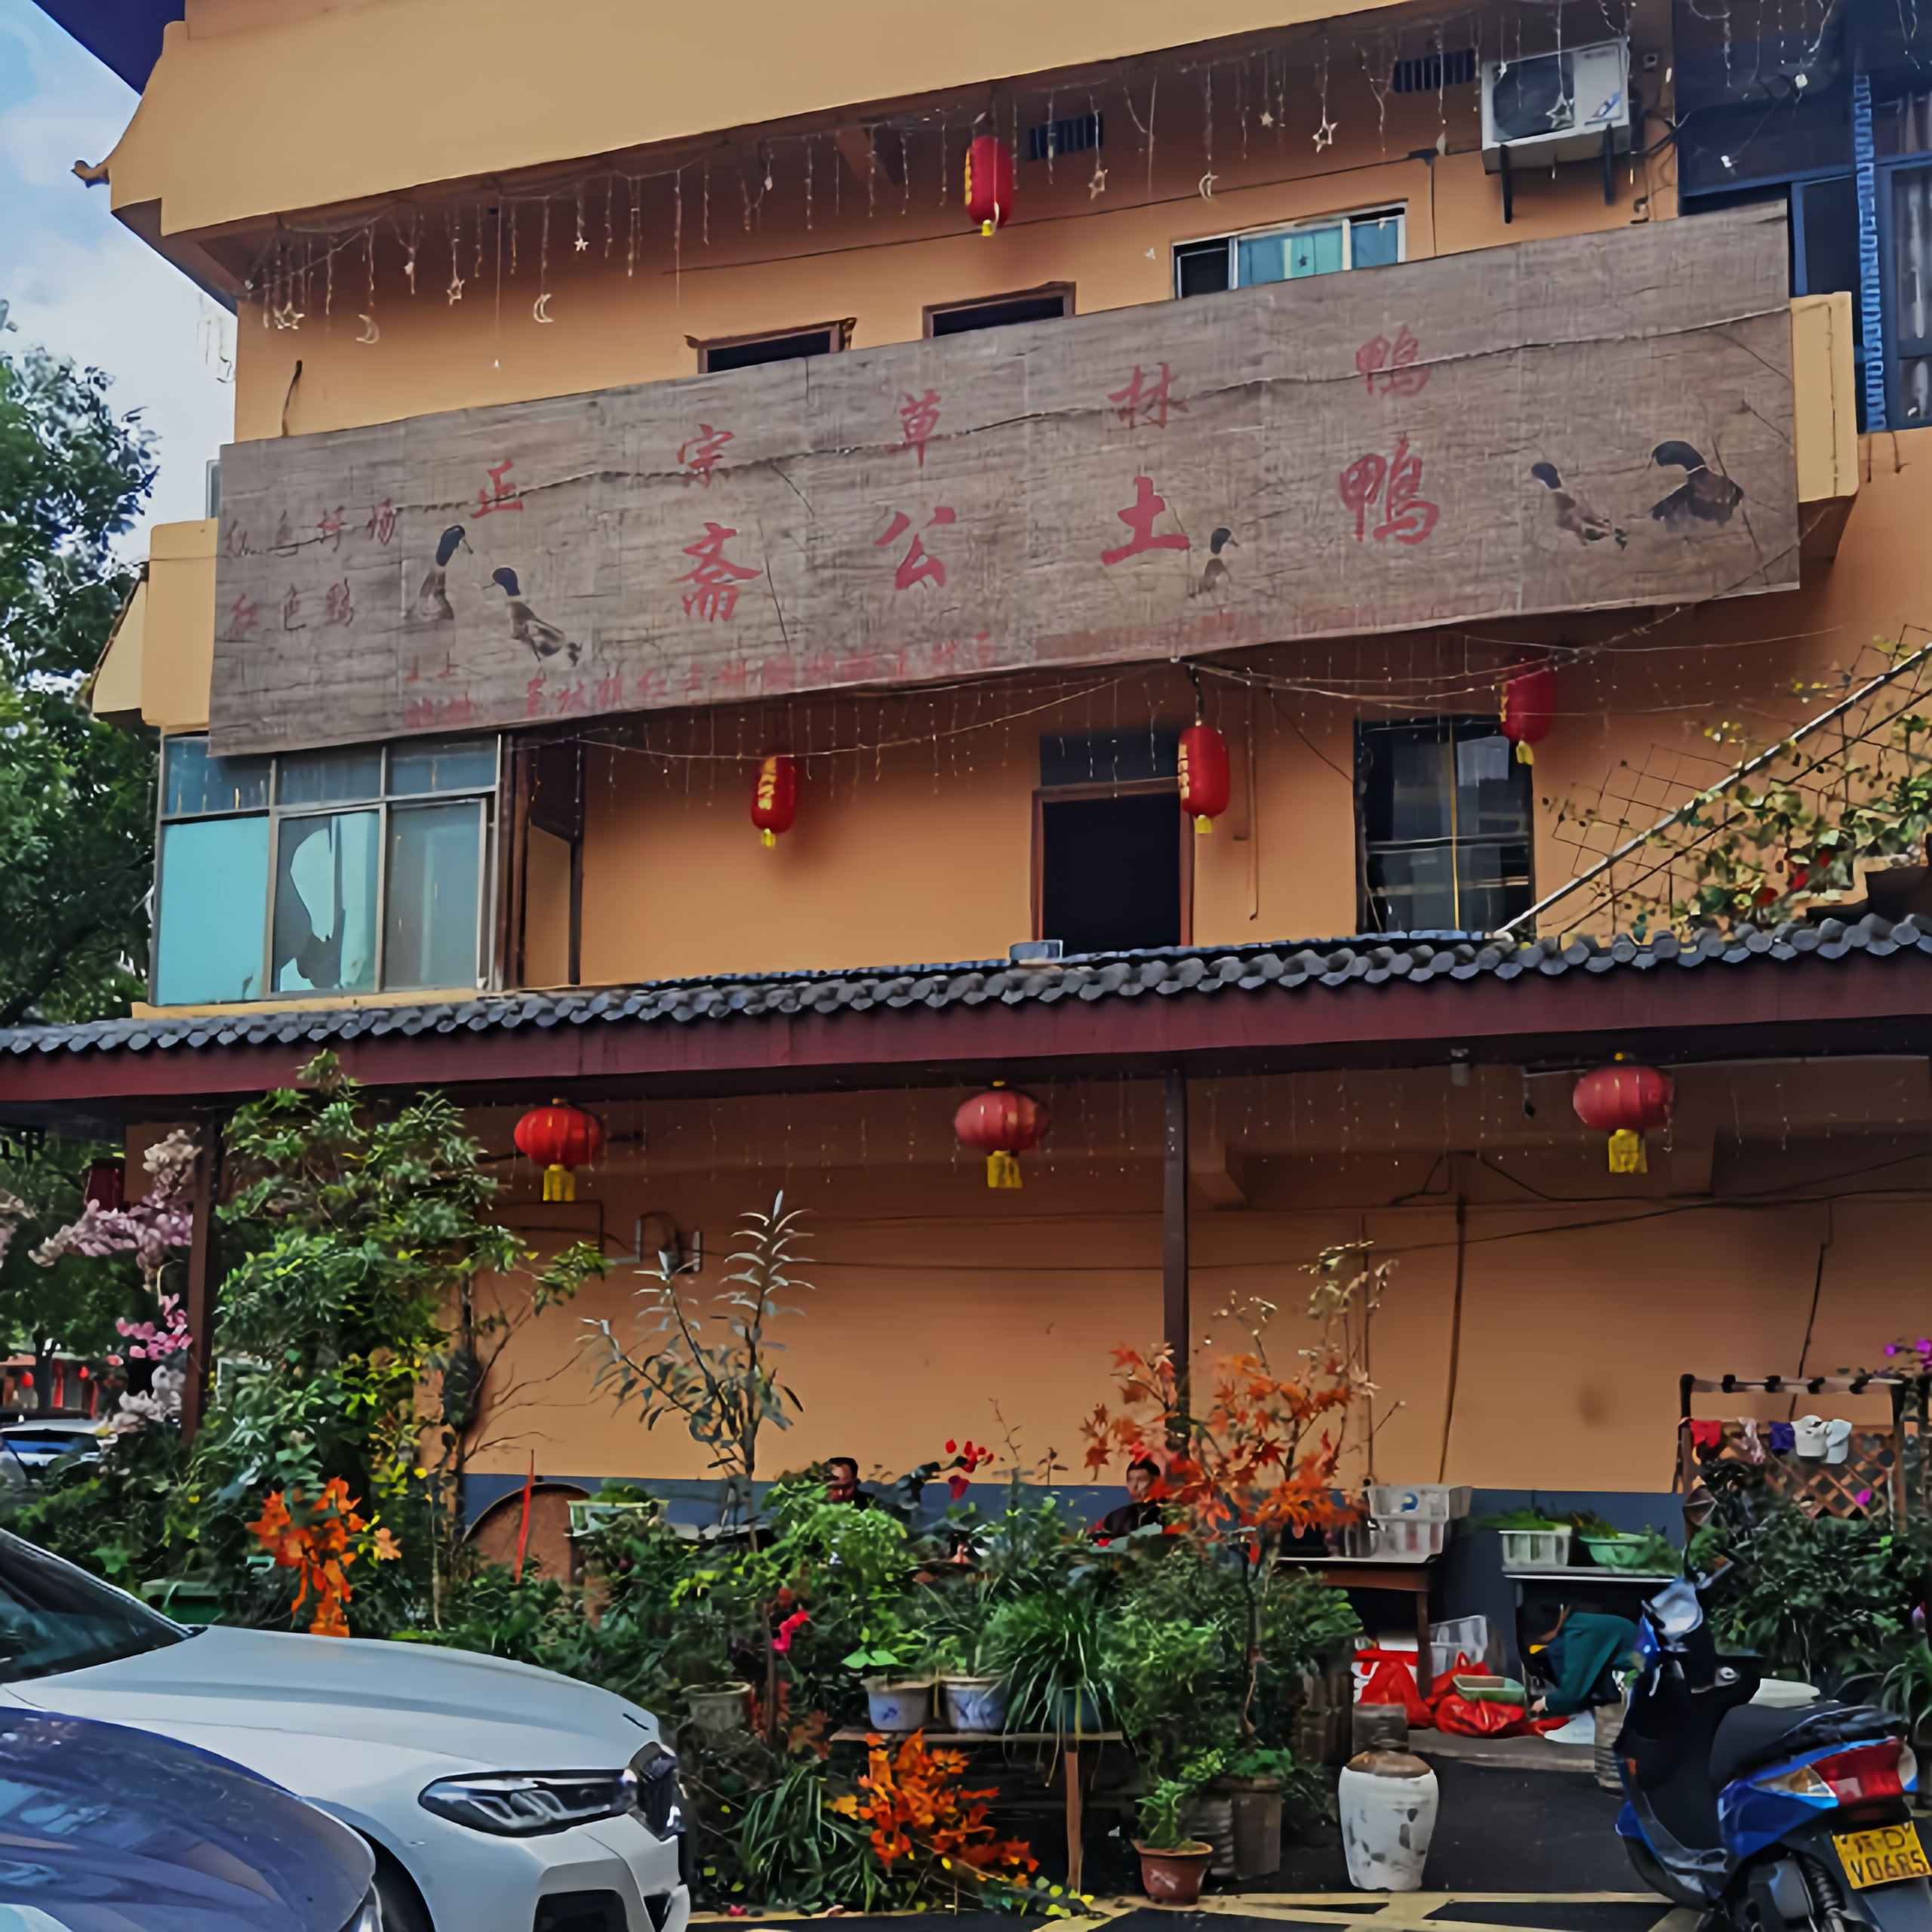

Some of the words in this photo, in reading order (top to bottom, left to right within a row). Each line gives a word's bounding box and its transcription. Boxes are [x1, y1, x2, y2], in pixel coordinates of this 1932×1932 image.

[471, 325, 1432, 519] 正宗草林鸭
[673, 439, 1440, 622] 斋公土鸭
